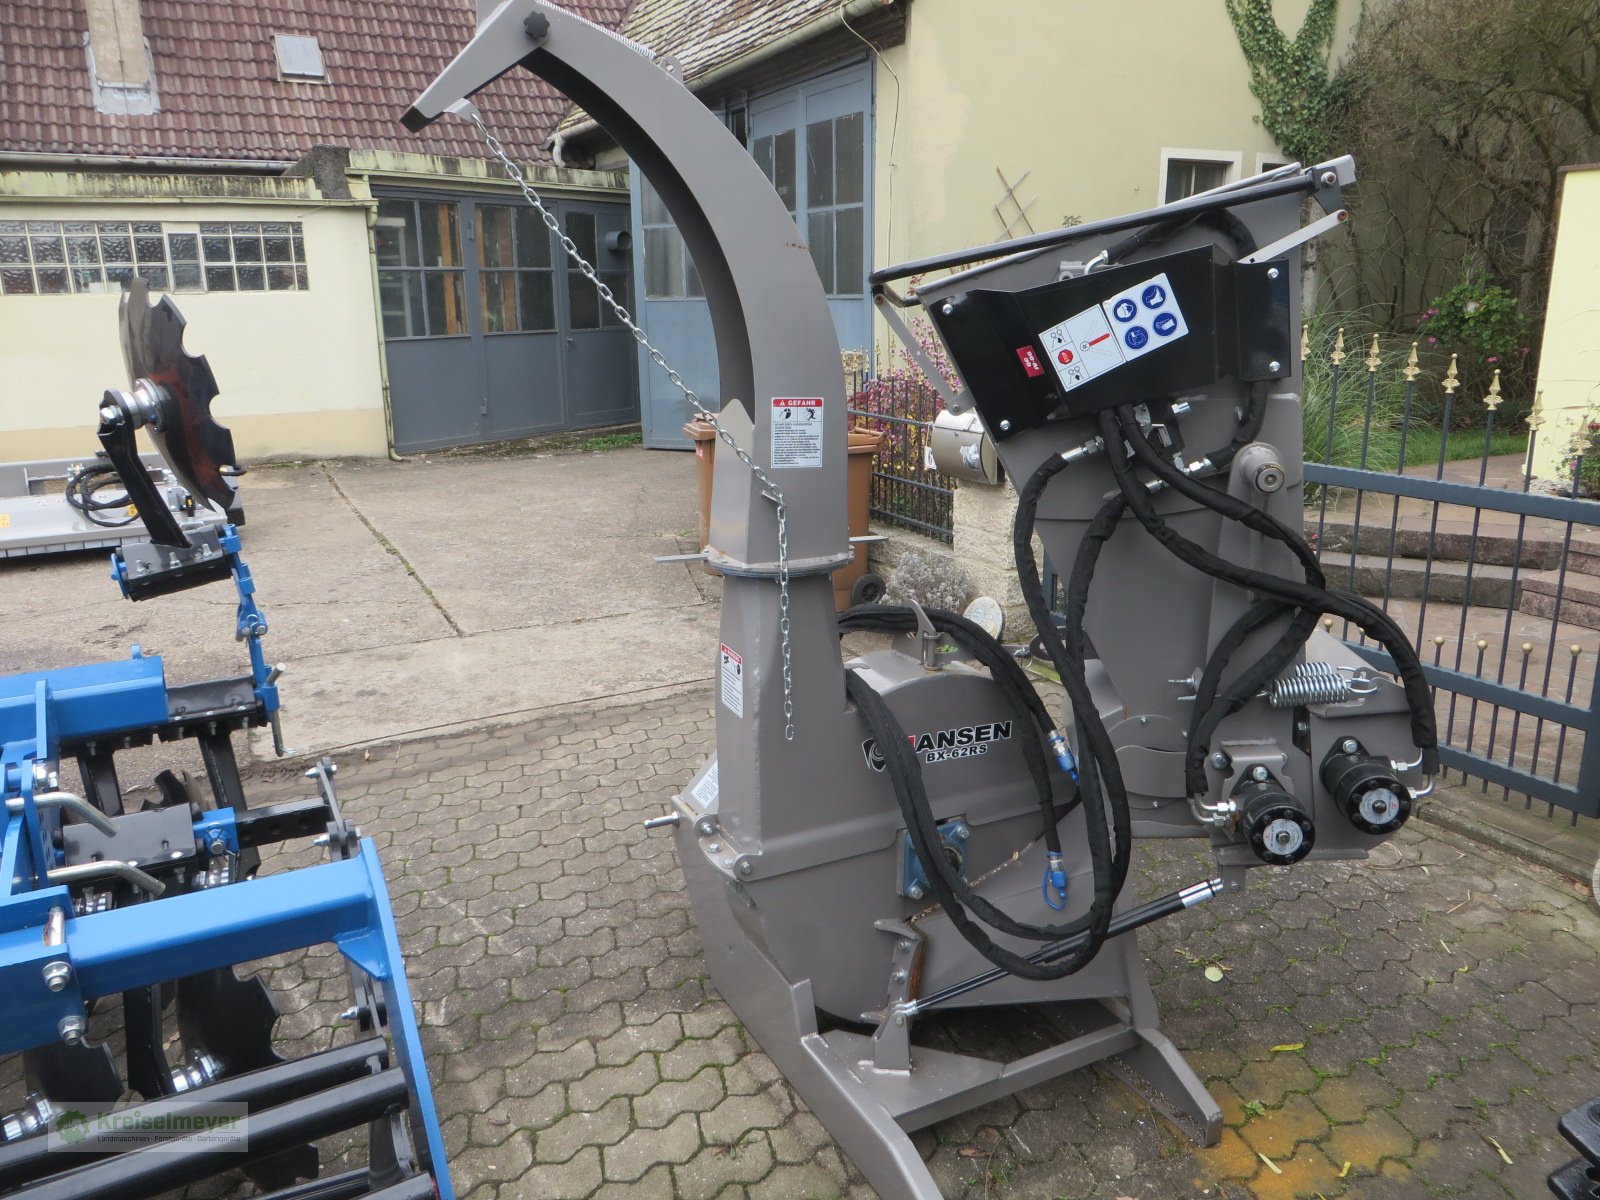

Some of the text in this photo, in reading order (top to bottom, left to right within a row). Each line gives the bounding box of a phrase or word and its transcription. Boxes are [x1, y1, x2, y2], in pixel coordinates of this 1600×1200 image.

[1061, 352, 1070, 363] STOP
[907, 720, 1013, 754] ANSEN
[925, 743, 988, 764] BX-62RS
